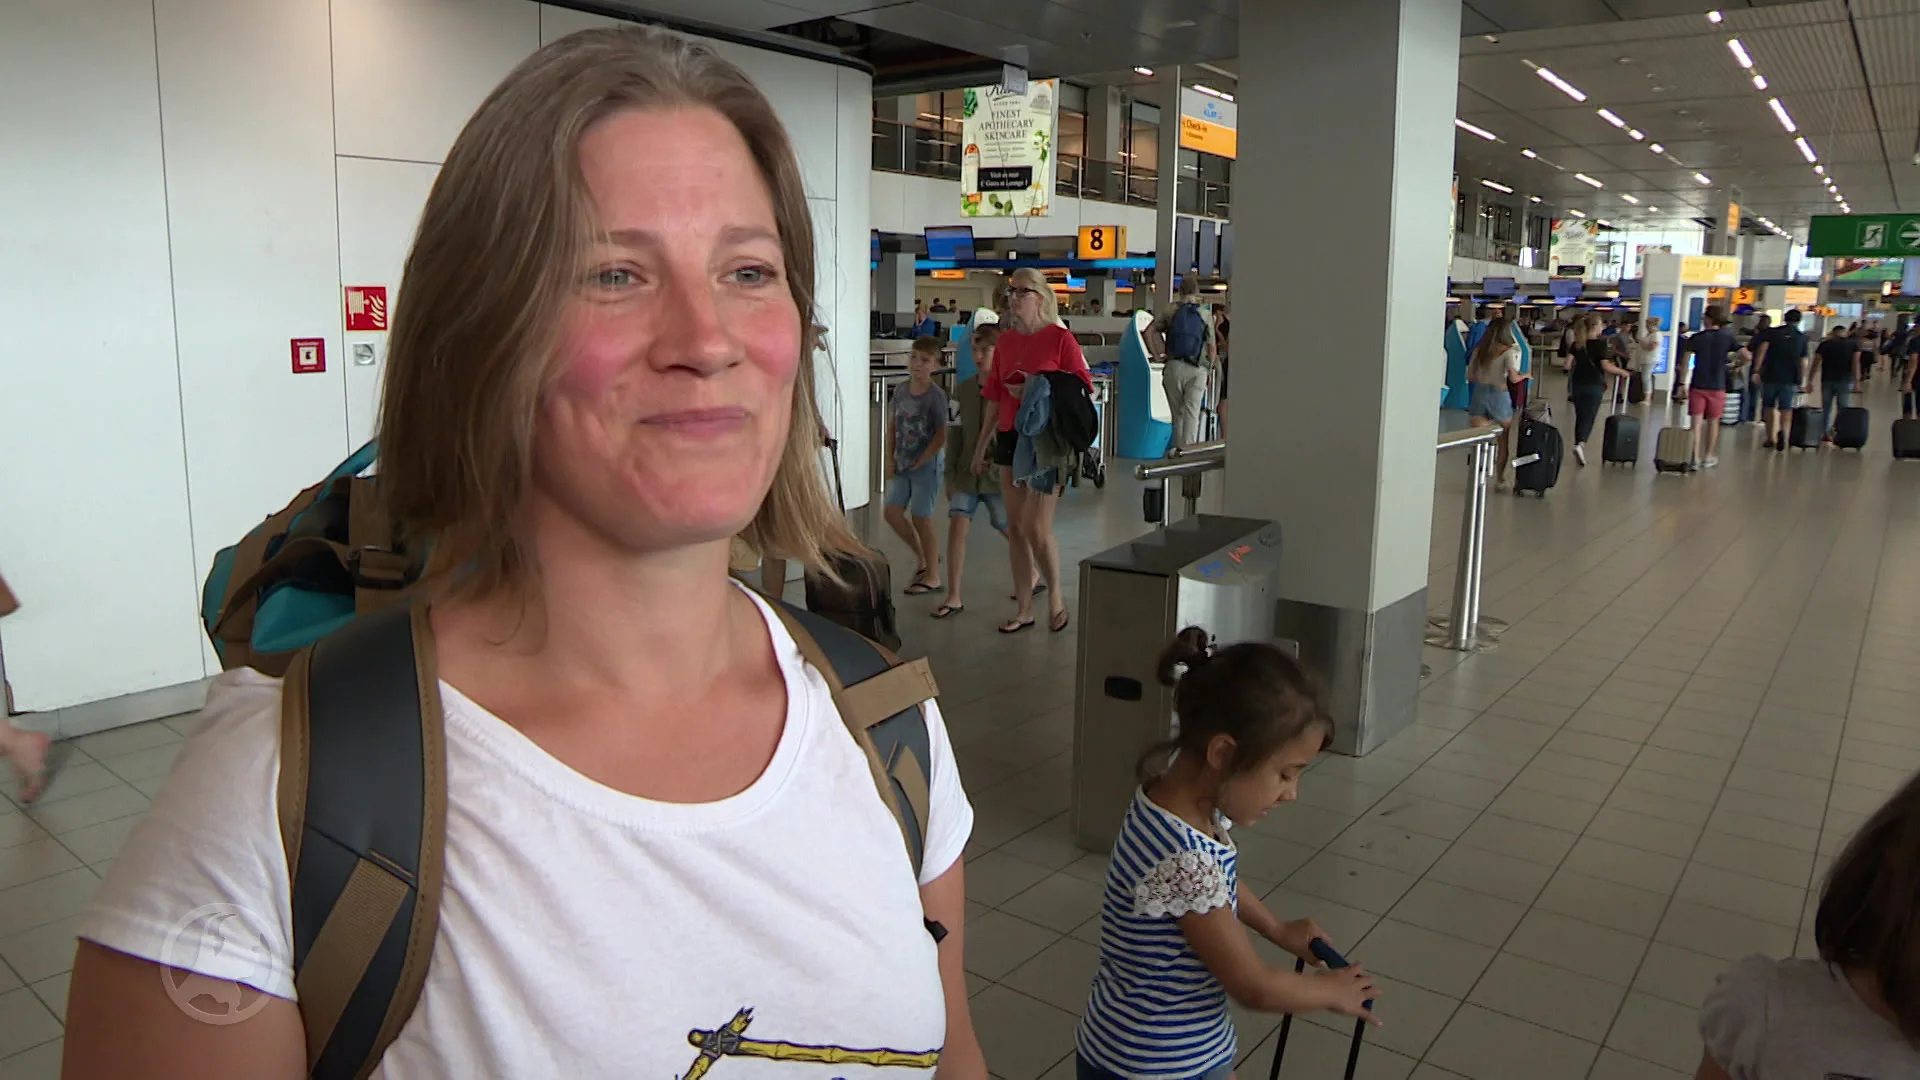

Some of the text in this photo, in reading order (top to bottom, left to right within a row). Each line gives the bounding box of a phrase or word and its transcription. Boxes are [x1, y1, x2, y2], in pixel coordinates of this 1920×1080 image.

[991, 109, 1021, 120] FINEST
[979, 119, 1034, 131] APOTHECARY
[984, 130, 1026, 140] SKINCARE
[1090, 229, 1104, 250] 8
